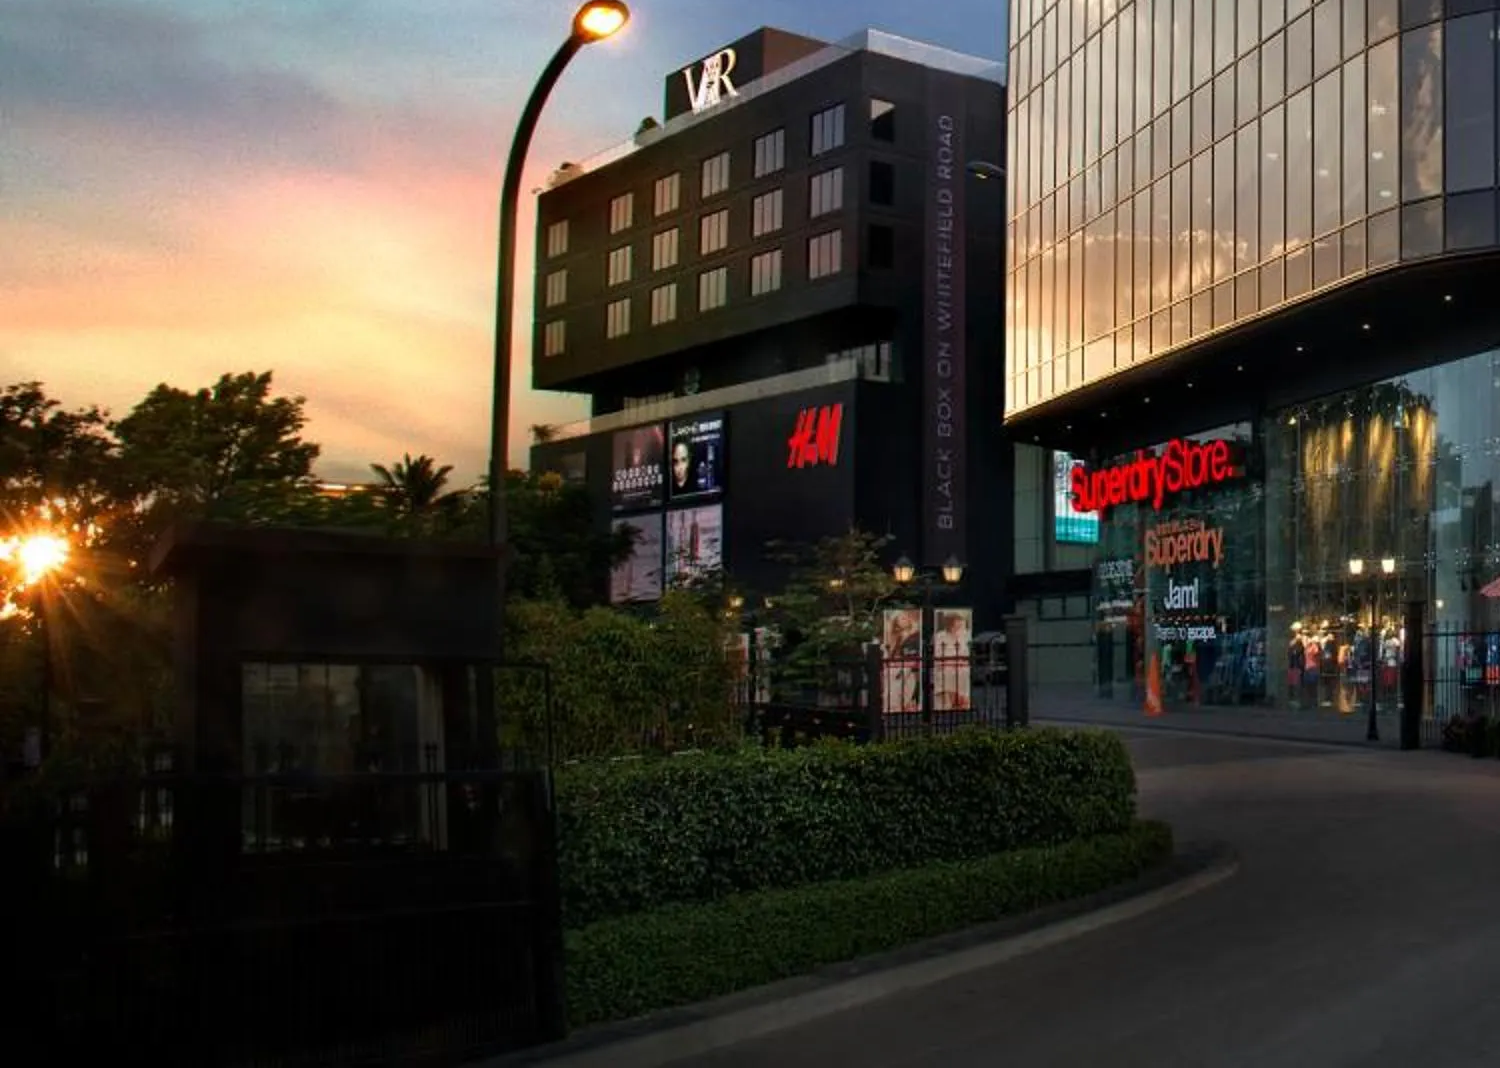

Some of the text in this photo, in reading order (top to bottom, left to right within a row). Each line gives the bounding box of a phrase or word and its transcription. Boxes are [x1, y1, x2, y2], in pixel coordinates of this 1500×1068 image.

[936, 114, 953, 180] ROAD
[936, 342, 952, 378] ON
[787, 403, 843, 468] H&M
[936, 386, 952, 437] BOX
[936, 447, 953, 529] BLACK
[1164, 577, 1199, 610] Jam!
